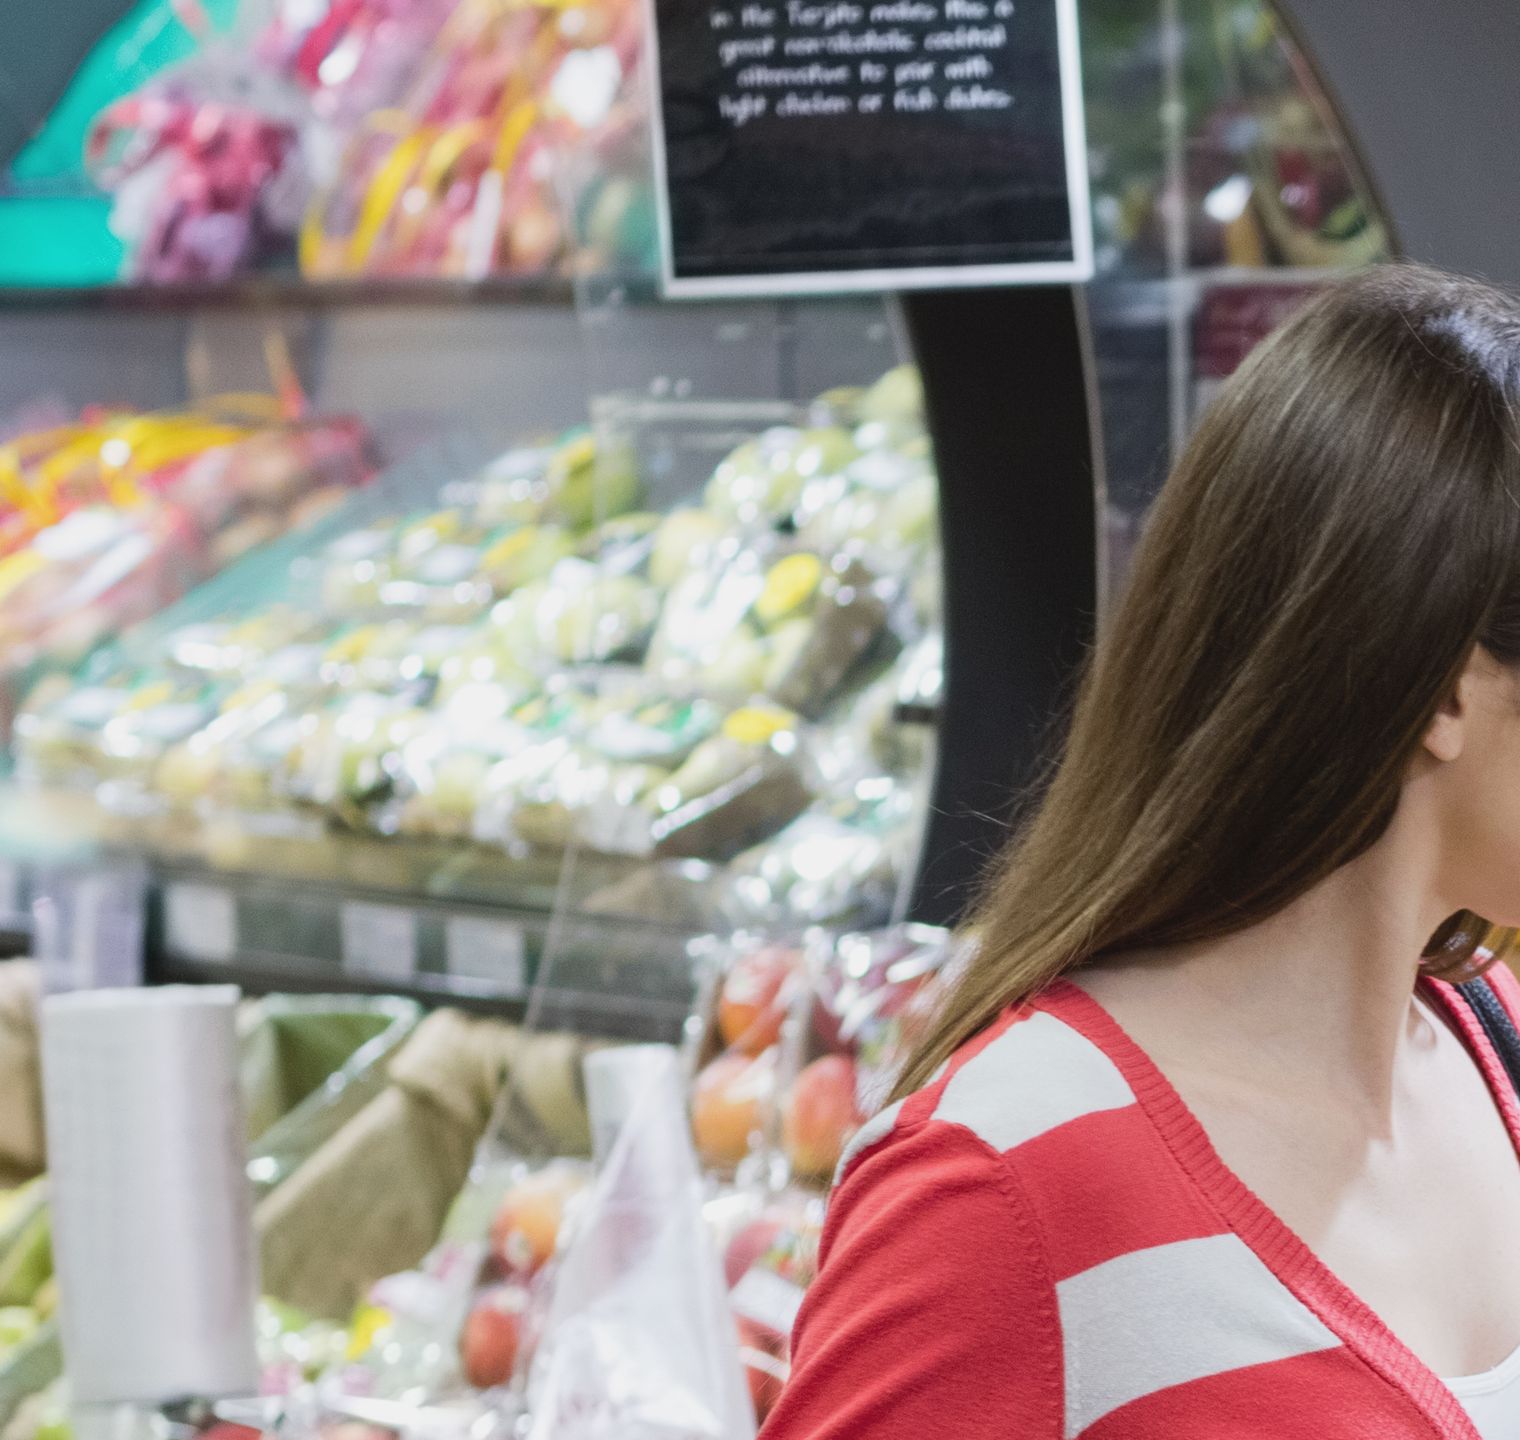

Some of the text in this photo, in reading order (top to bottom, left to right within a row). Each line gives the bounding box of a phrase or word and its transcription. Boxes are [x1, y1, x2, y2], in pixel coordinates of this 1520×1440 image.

[741, 4, 775, 28] the
[869, 0, 938, 23] makes
[944, 0, 989, 20] this
[718, 35, 776, 68] great
[923, 22, 1007, 51] cocktail
[736, 53, 994, 88] alternative to pair with
[718, 92, 768, 127] light
[775, 91, 853, 118] chicken
[857, 92, 884, 114] or
[893, 85, 939, 112] fish
